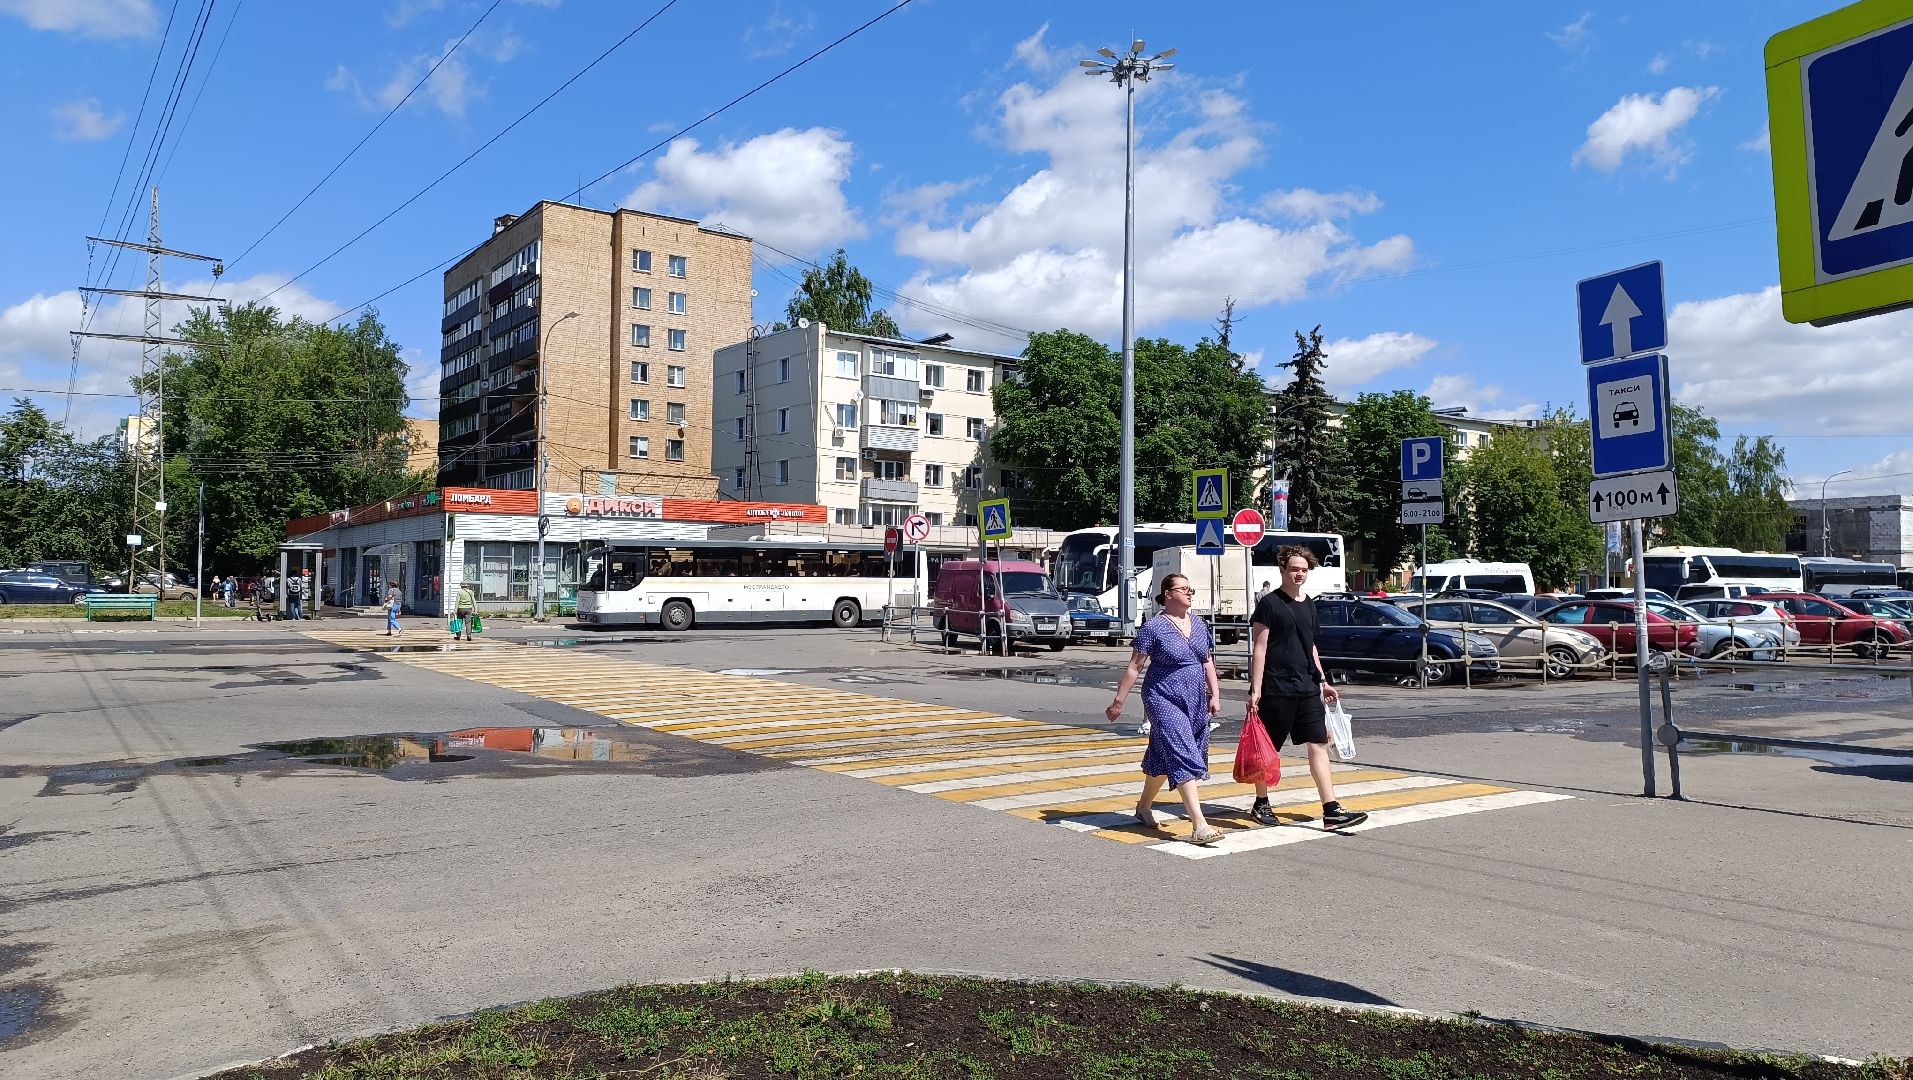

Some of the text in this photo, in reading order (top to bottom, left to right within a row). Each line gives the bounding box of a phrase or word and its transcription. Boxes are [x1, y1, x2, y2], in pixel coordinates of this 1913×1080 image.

[1609, 385, 1640, 396] ТАКСИ
[1412, 443, 1431, 475] P
[450, 494, 492, 504] ЛОМБАРД
[587, 499, 657, 516] ДИКСИ
